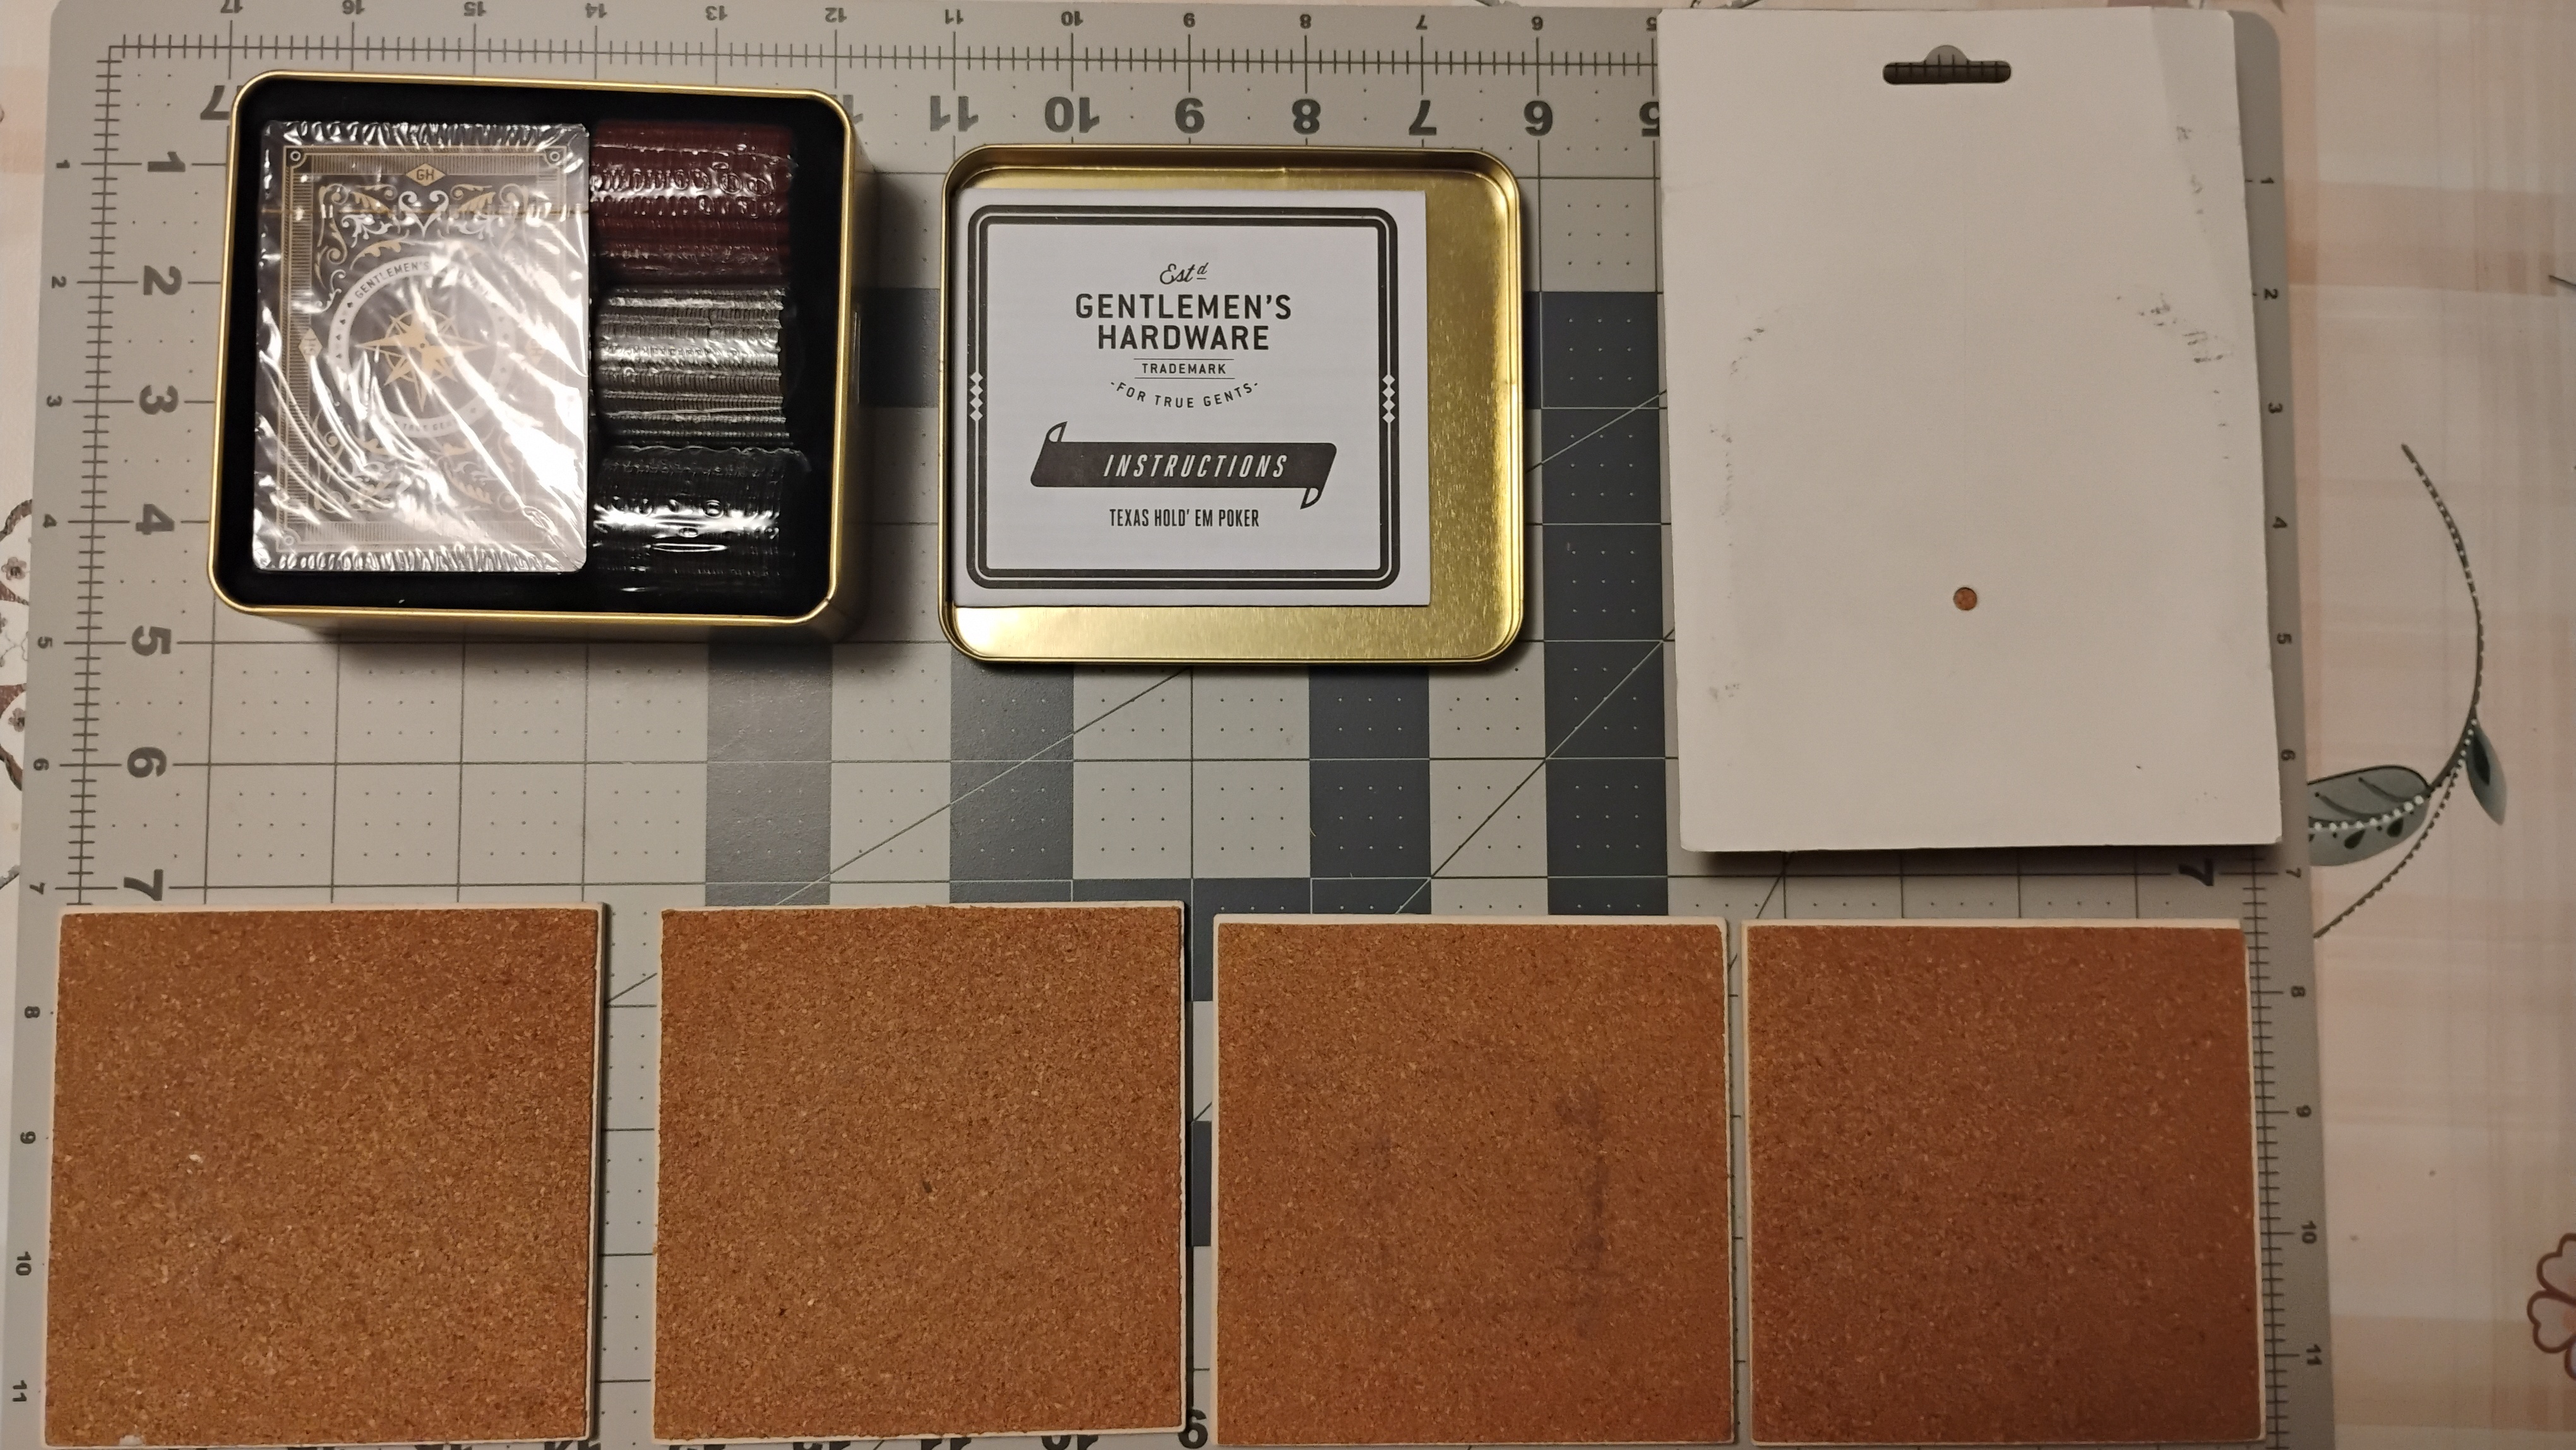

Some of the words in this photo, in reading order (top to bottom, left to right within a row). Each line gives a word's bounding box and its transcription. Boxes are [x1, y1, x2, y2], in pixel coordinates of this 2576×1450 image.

[220, 0, 243, 13] 17
[342, 0, 365, 15] 16
[464, 1, 486, 16] 15
[585, 3, 607, 18] 14
[705, 6, 727, 21] 13
[825, 8, 847, 23] 12
[945, 9, 963, 24] 11
[1061, 11, 1083, 26] 10
[1300, 14, 1311, 29] 8
[1416, 15, 1428, 30] 7
[1646, 17, 1657, 32] 5
[930, 95, 979, 131] 11
[1045, 97, 1100, 133] 10
[1292, 99, 1321, 135] 8
[1409, 100, 1436, 135] 7
[1639, 101, 1659, 137] 5
[56, 160, 70, 169] 1
[148, 152, 186, 172] 1
[416, 169, 435, 181] GH
[52, 276, 66, 289] 2
[143, 265, 182, 296] 2
[355, 261, 430, 299] GENTLEMEN'S
[2264, 289, 2278, 299] 2
[1076, 294, 1291, 320] GENTLEMEN'S
[1099, 325, 1268, 350] HARDWARE
[1142, 363, 1225, 374] TRADEMARK
[47, 395, 62, 407] 3
[139, 385, 178, 415] 3
[1155, 395, 1193, 408] TRUE
[2268, 403, 2282, 414] 3
[1104, 455, 1287, 477] INSTRUCTIONS
[43, 514, 57, 528] 4
[136, 504, 174, 535] 4
[1110, 509, 1148, 526] TEXAS
[1155, 509, 1190, 527] HOLD'
[1195, 510, 1212, 526] EM
[1219, 509, 1259, 527] POKER
[2272, 517, 2287, 529] 4
[37, 637, 52, 649] 5
[131, 626, 171, 656] 5
[2277, 633, 2292, 644] 5
[128, 747, 167, 778] 6
[2281, 749, 2296, 761] 6
[33, 758, 49, 770] 6
[2179, 858, 2214, 887] 7
[2285, 868, 2301, 878] 7
[30, 882, 45, 895] 7
[124, 869, 164, 901] 7
[2291, 986, 2306, 998] 8
[25, 1006, 40, 1019] 8
[2296, 1105, 2311, 1118] 9
[20, 1131, 36, 1144] 9
[2301, 1221, 2317, 1244] 10
[16, 1252, 32, 1276] 10
[2306, 1344, 2322, 1365] 11
[13, 1380, 27, 1402] 11
